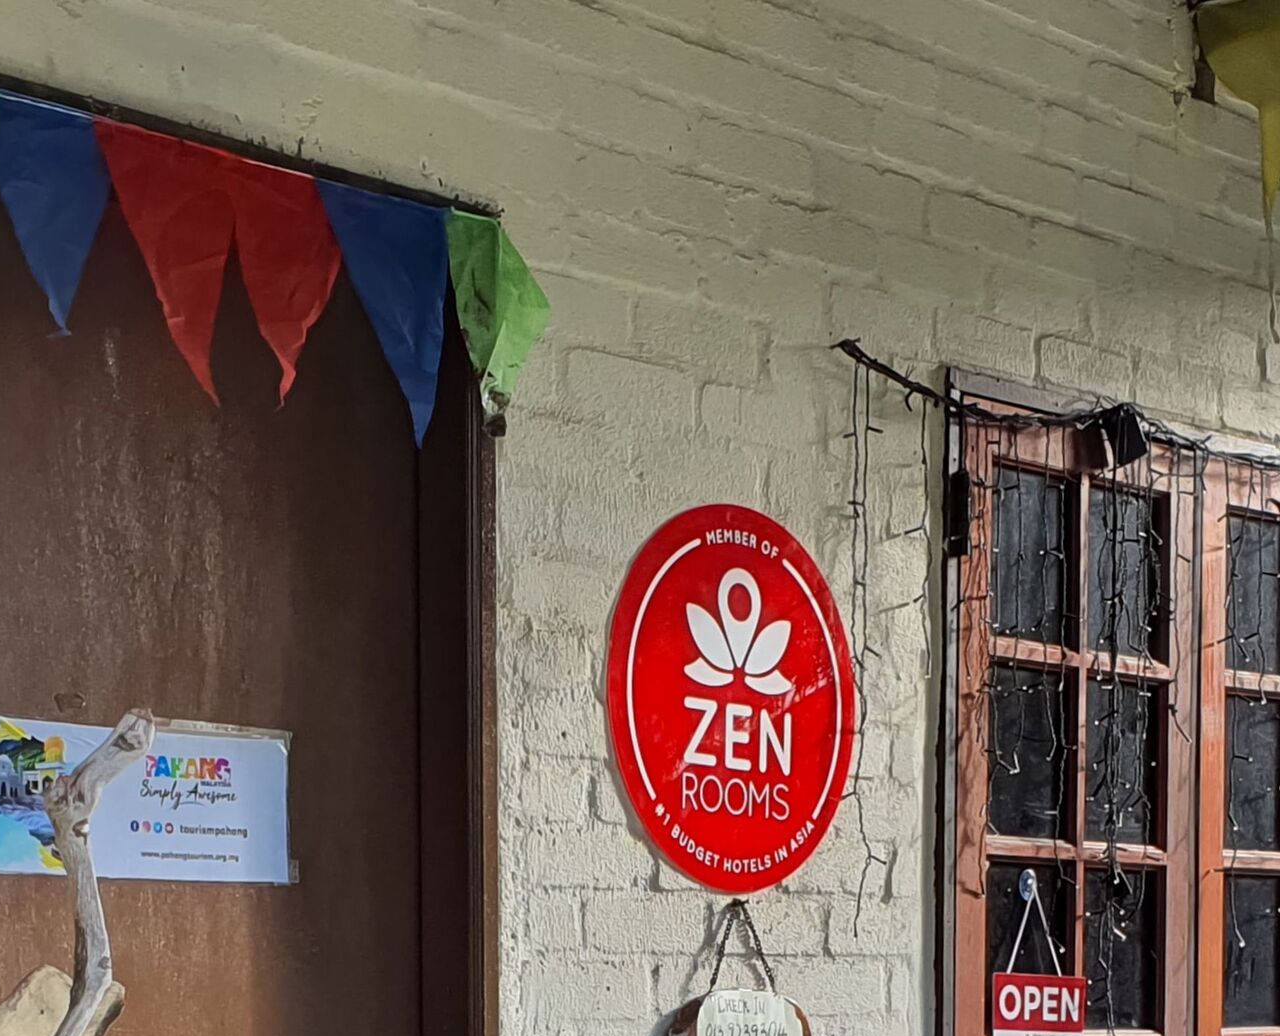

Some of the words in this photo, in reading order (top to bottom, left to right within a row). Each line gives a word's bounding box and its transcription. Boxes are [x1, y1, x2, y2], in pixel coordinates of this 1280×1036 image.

[706, 529, 757, 549] MEMBER
[761, 540, 780, 559] OF
[682, 696, 791, 776] ZEN
[145, 755, 231, 780] PAHANG
[140, 778, 182, 810] Simply
[186, 783, 238, 804] Awesome
[682, 772, 790, 821] ROOMS
[179, 825, 248, 839] tourismpahang
[654, 803, 671, 826] #1
[671, 824, 721, 868] BUDGET
[723, 854, 772, 873] HOTELS
[774, 846, 789, 864] IN
[790, 821, 815, 853] ASIA
[718, 995, 750, 1014] CHECK
[998, 984, 1080, 1022] OPEN
